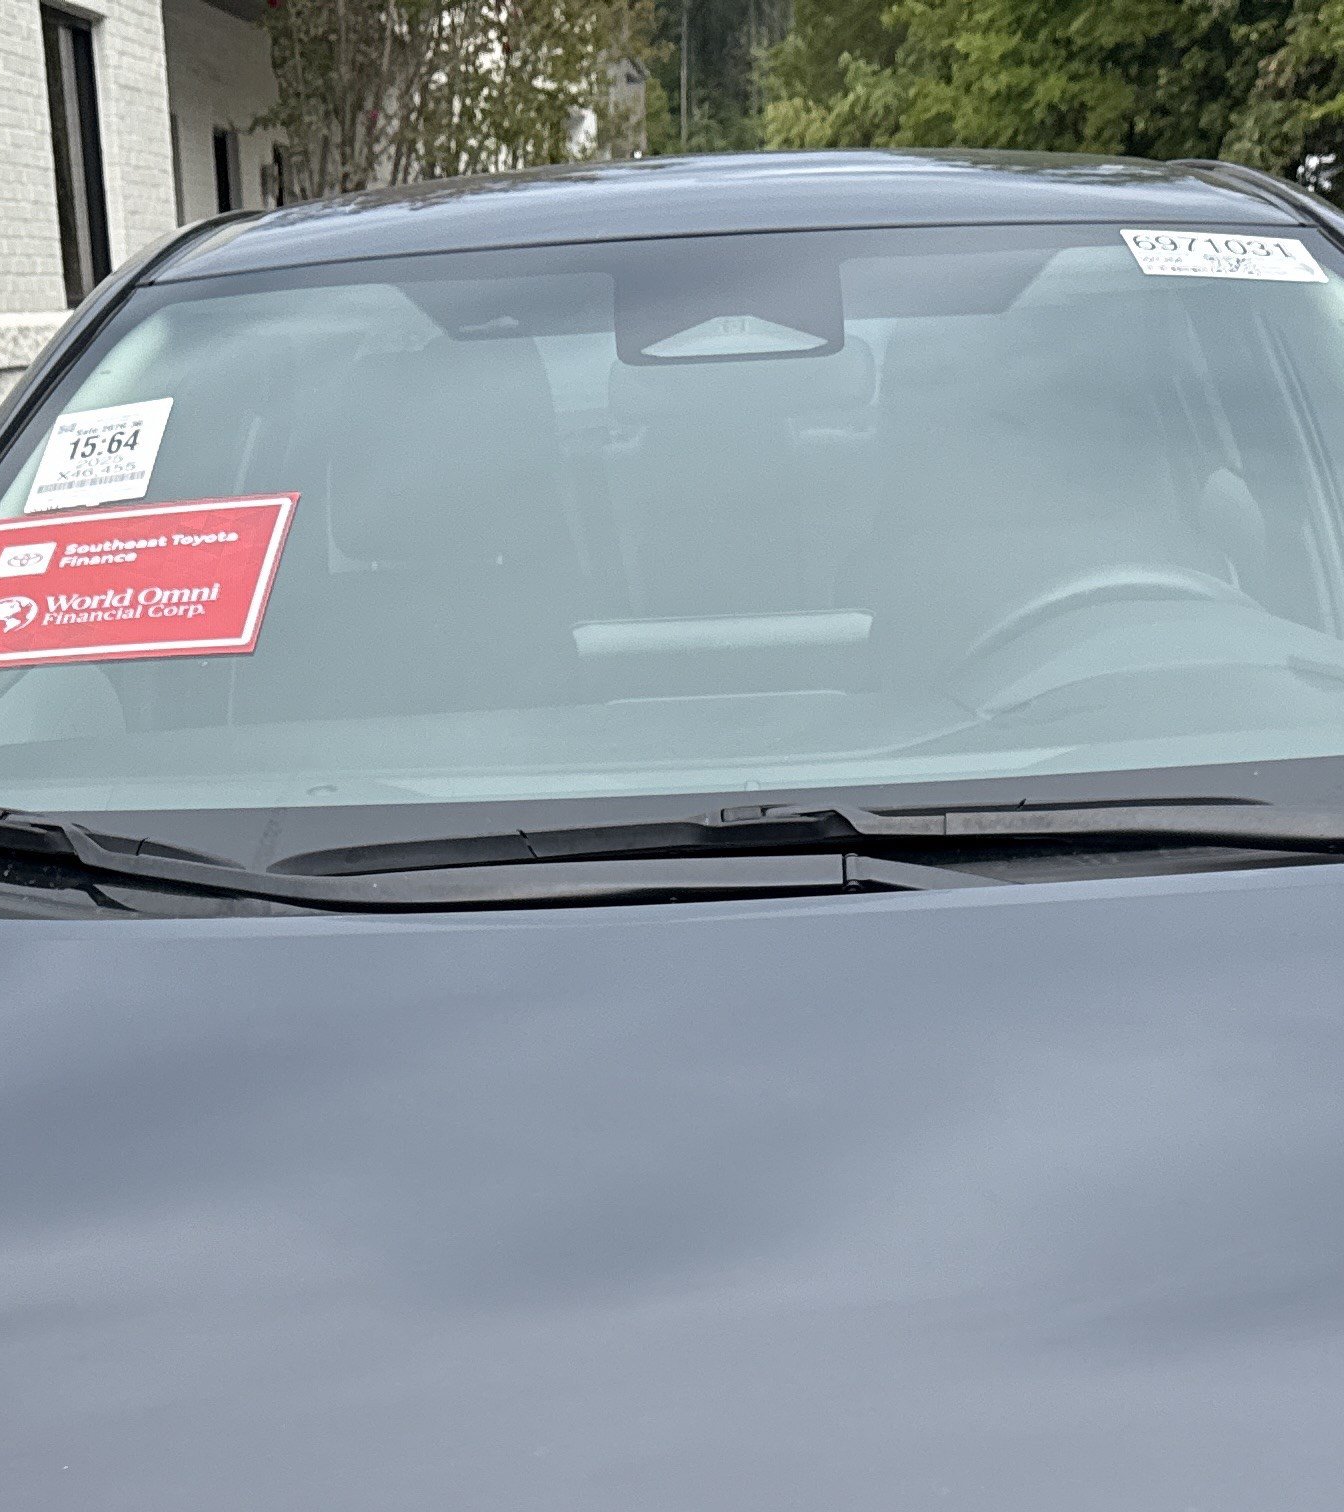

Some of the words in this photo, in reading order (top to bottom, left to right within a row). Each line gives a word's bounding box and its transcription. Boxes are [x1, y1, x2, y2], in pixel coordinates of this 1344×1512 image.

[1132, 235, 1293, 258] 6971031
[69, 429, 141, 460] 15:64
[64, 536, 168, 555] Southeast
[172, 531, 239, 546] Toyota
[58, 551, 138, 568] Finance
[46, 588, 134, 612] World
[137, 582, 220, 606] Omni
[41, 606, 142, 626] Financial
[147, 602, 205, 618] Corp.
